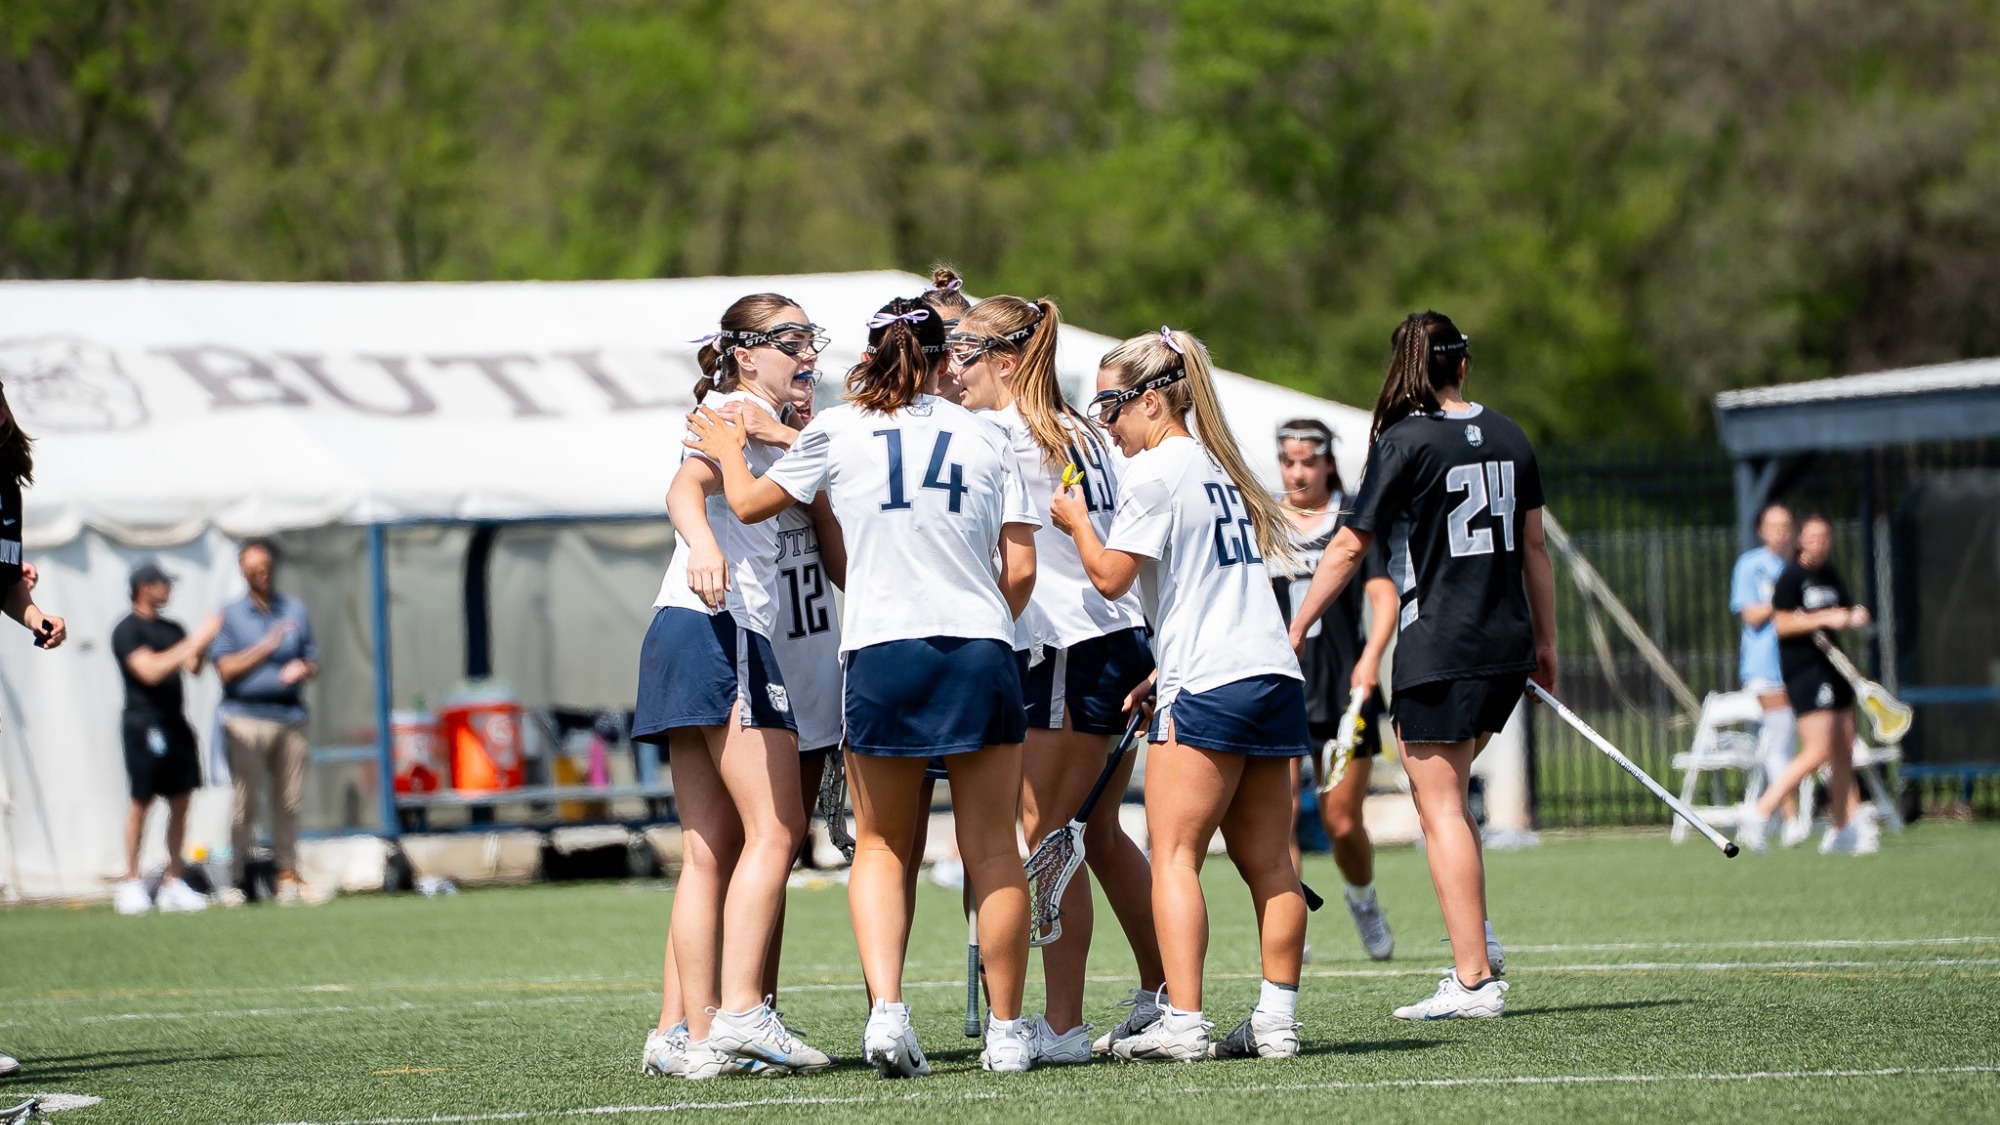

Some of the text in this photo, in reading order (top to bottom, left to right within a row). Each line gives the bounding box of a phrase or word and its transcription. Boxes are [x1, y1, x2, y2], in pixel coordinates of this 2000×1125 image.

[738, 331, 763, 339] ST
[745, 334, 768, 347] STX
[867, 345, 877, 354] STX
[922, 345, 940, 353] STX
[146, 343, 697, 418] BUTL
[1146, 374, 1172, 389] STX
[872, 428, 969, 514] 14
[1068, 435, 1115, 512] 19
[1203, 482, 1264, 567] 22
[1446, 461, 1516, 557] 24
[780, 562, 831, 640] 12
